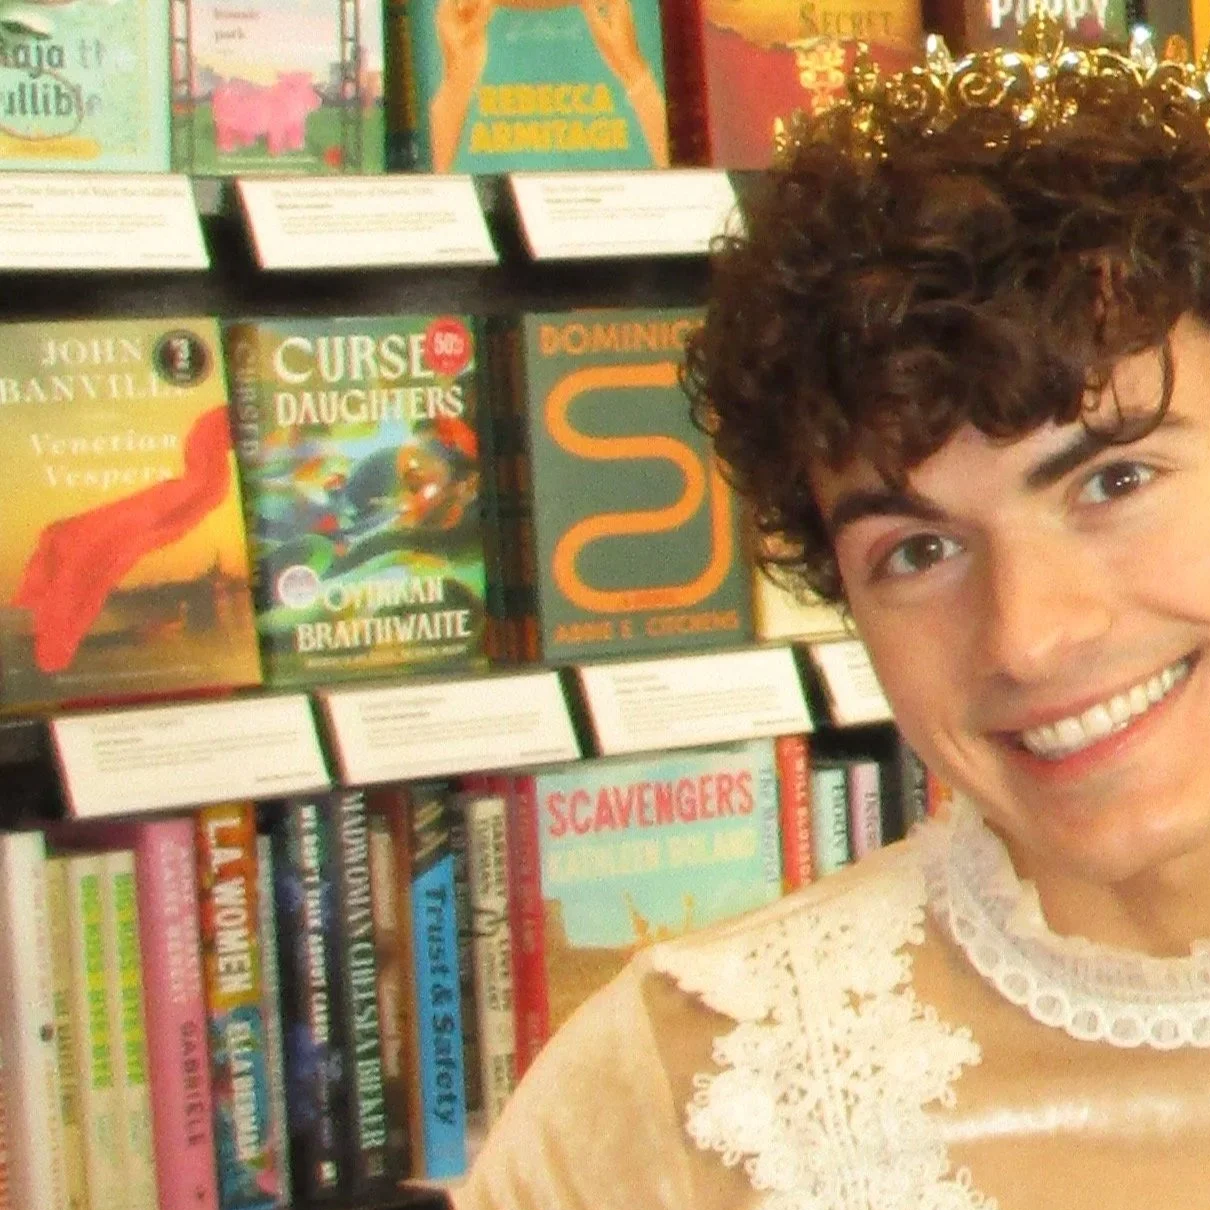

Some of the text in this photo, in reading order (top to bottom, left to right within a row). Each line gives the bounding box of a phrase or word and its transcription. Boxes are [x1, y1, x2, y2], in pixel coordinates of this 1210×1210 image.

[476, 82, 614, 117] REBECCA
[467, 118, 628, 153] ARMITAGE
[41, 336, 142, 367] JOHN
[274, 384, 465, 426] DAUGHTERS
[29, 431, 180, 456] Venetian
[44, 462, 175, 493] Vespers
[297, 608, 471, 652] BRAITHWAITE
[546, 769, 754, 839] SCAVENGERS
[212, 878, 254, 996] WOMEN
[340, 792, 387, 1150] MADWOMAN CHELSEA BIEKER
[425, 885, 459, 1129] Trust & Safety
